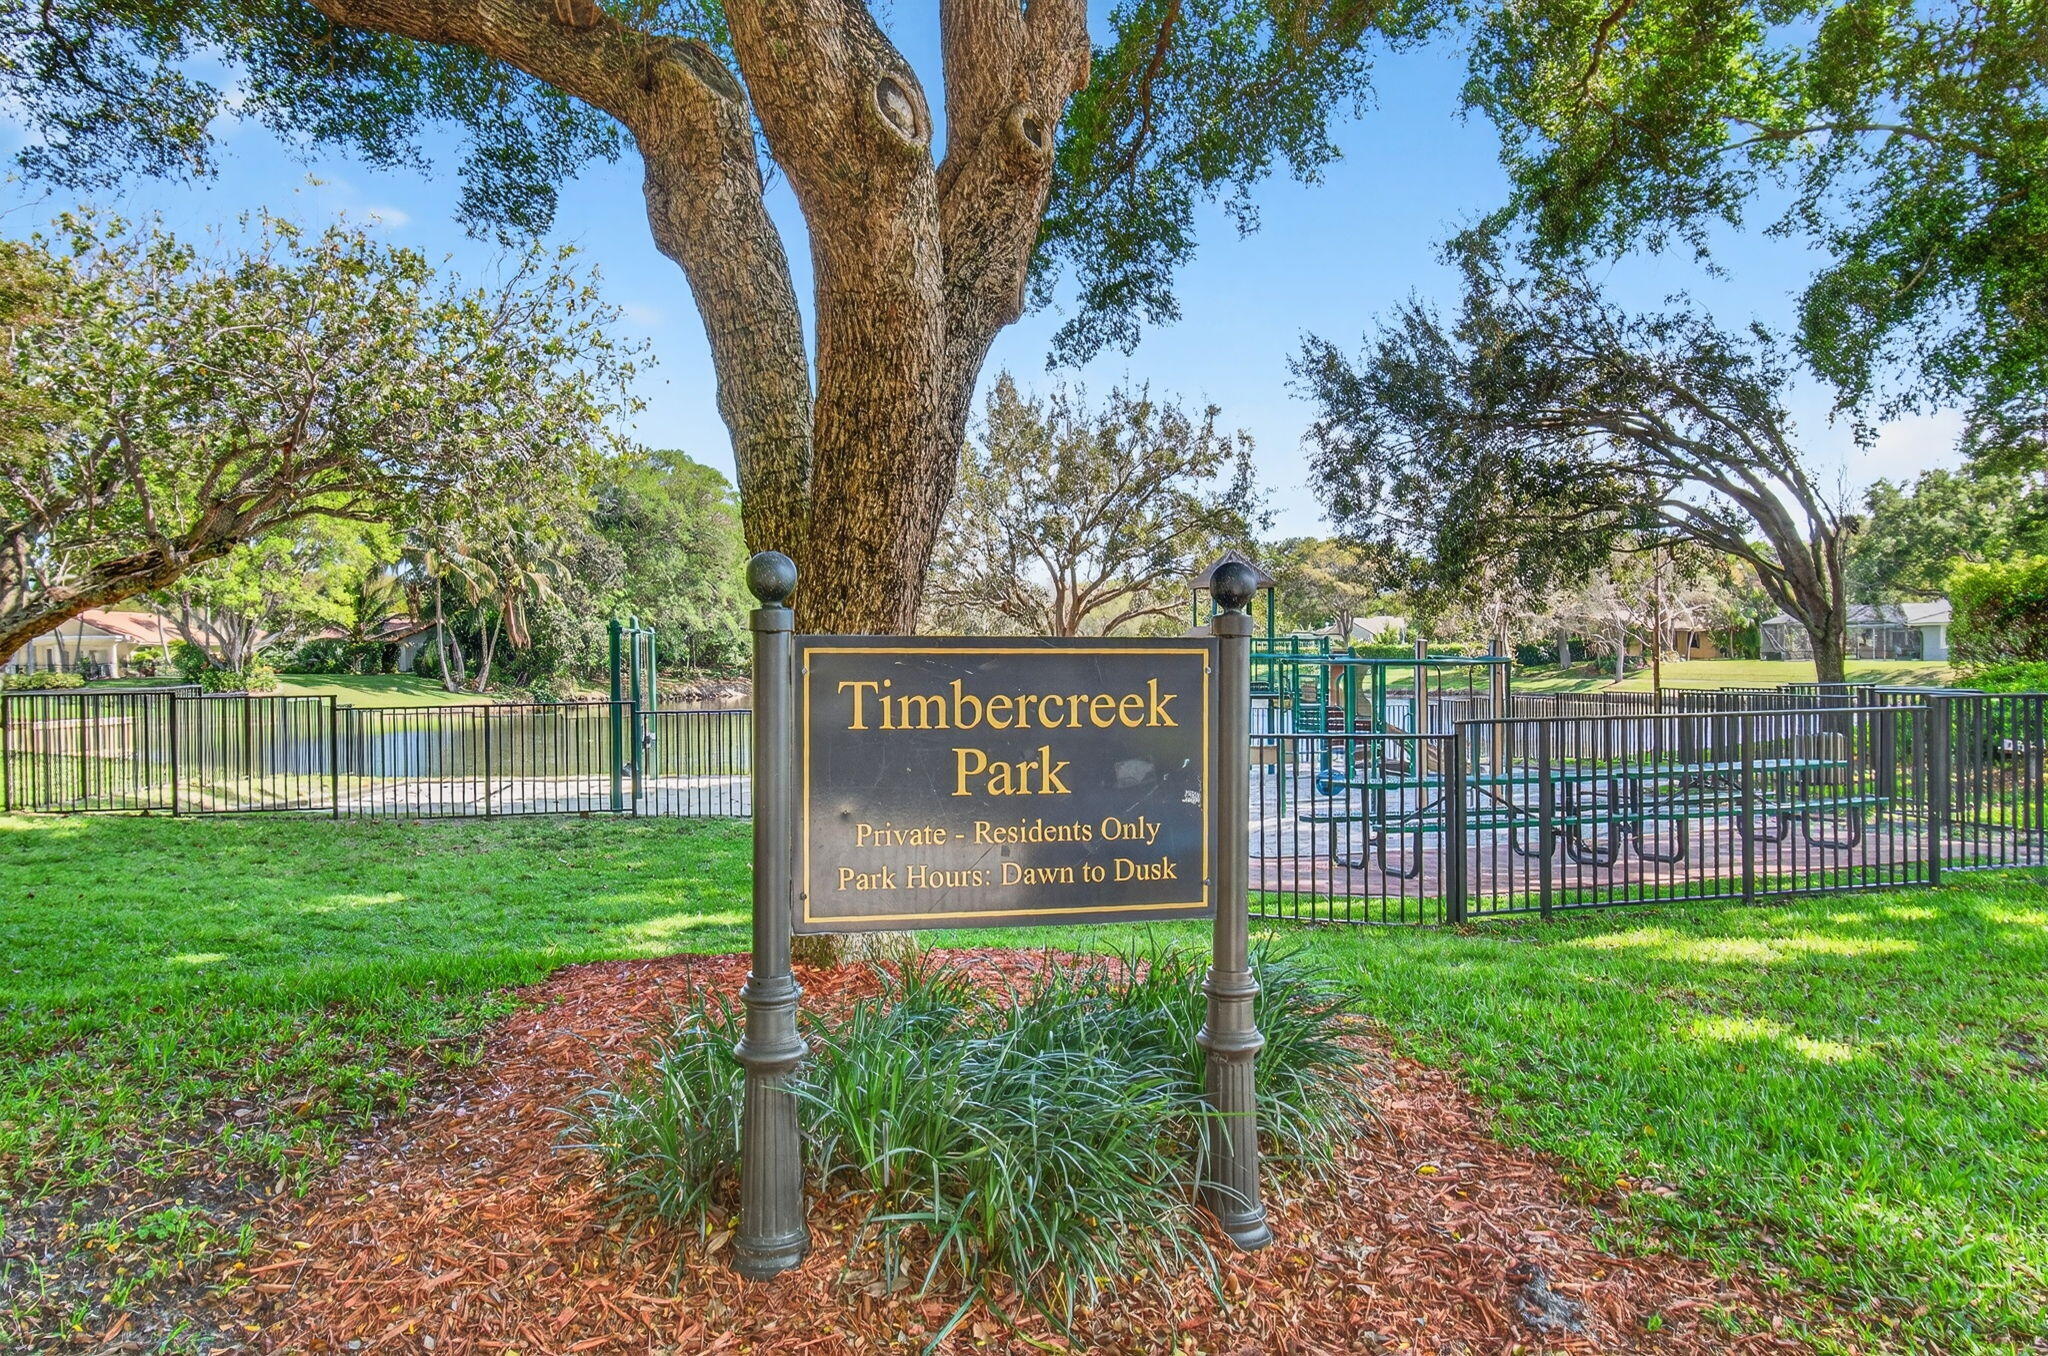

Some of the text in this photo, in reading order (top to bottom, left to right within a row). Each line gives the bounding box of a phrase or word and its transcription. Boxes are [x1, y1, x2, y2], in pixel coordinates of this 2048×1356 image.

[837, 678, 1179, 730] Timbercreek
[951, 745, 1071, 797] Park
[855, 821, 947, 847] Private
[974, 817, 1093, 844] Residents
[1101, 816, 1161, 846] Only
[837, 856, 1178, 891] Park Hours: Dawn to Dusk
